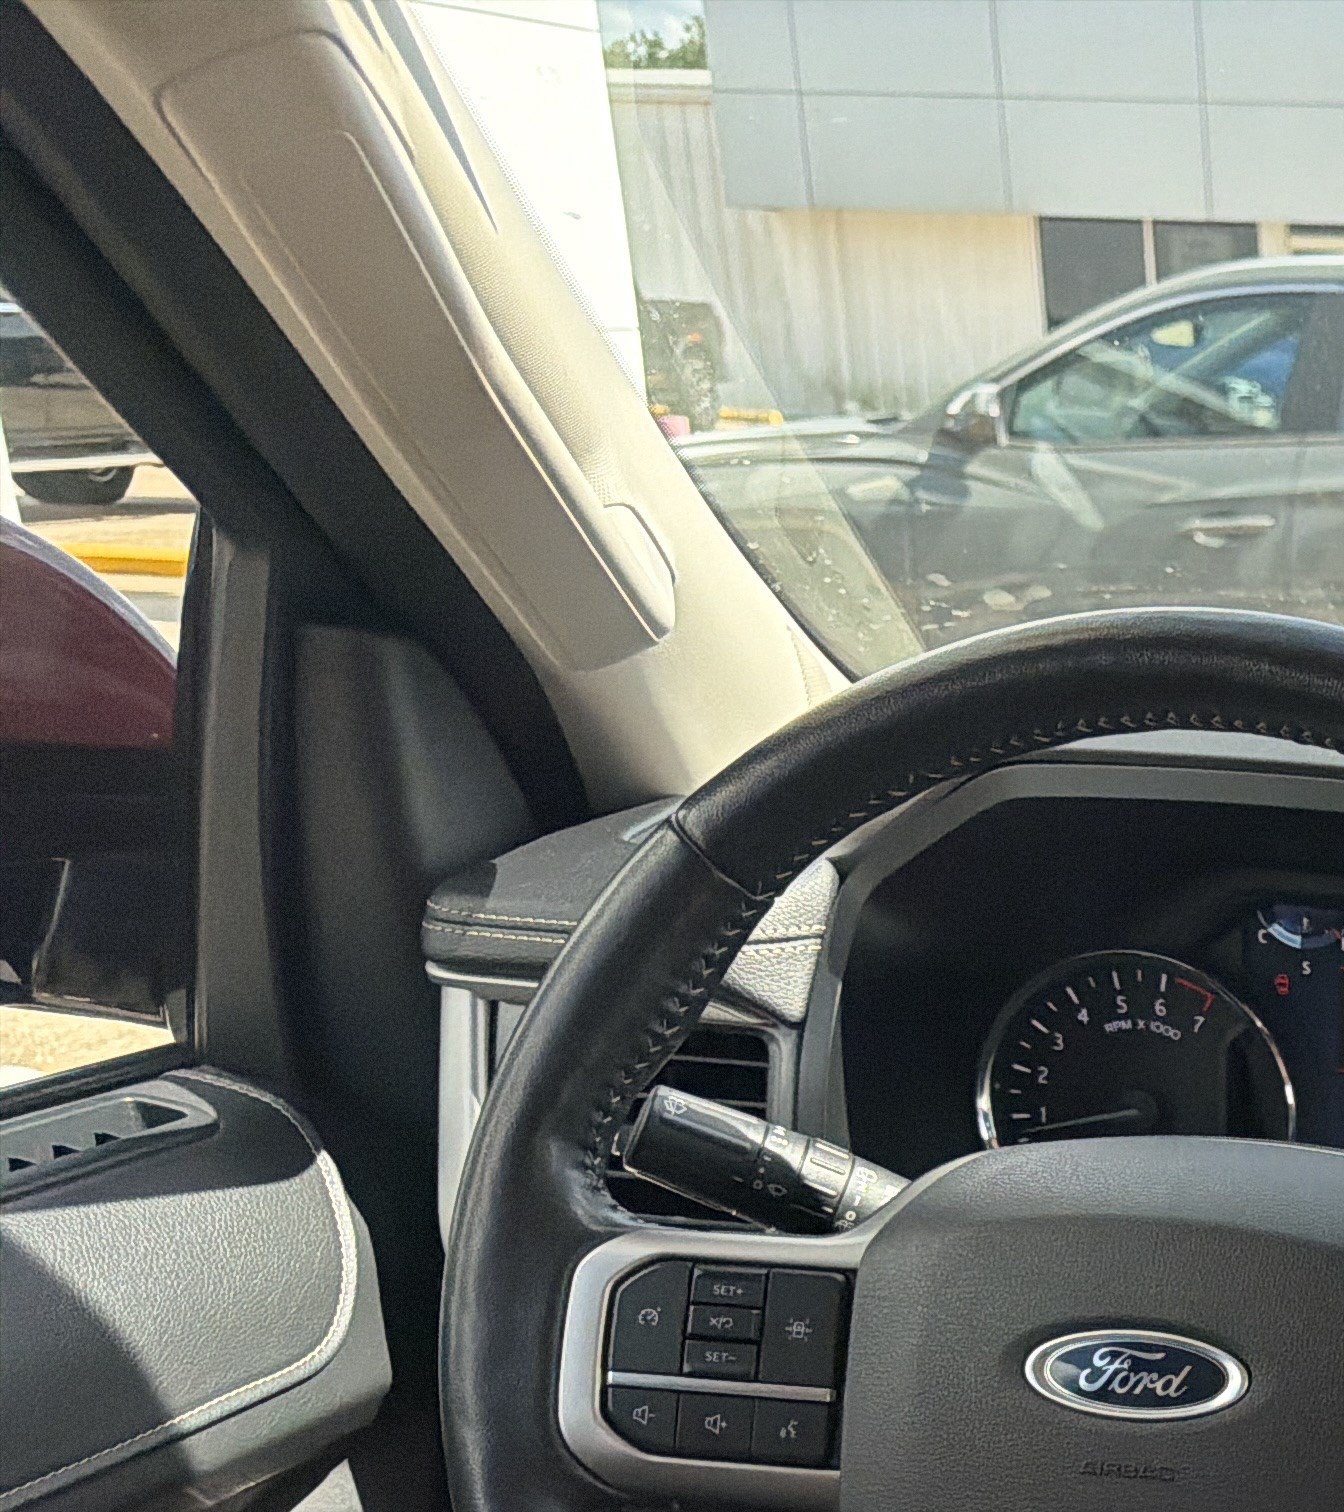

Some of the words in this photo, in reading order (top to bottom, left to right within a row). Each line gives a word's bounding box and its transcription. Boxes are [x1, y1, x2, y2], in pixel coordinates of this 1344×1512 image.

[1257, 928, 1268, 944] C
[1115, 995, 1128, 1014] 5
[1154, 998, 1167, 1017] 6
[1077, 1007, 1090, 1025] 4
[1193, 1015, 1206, 1033] 7
[1103, 1018, 1133, 1034] RPM
[1150, 1020, 1182, 1041] 1000
[1052, 1032, 1065, 1051] 3
[1037, 1065, 1049, 1085] 2
[1040, 1105, 1047, 1124] 1
[1078, 1346, 1193, 1398] Ford
